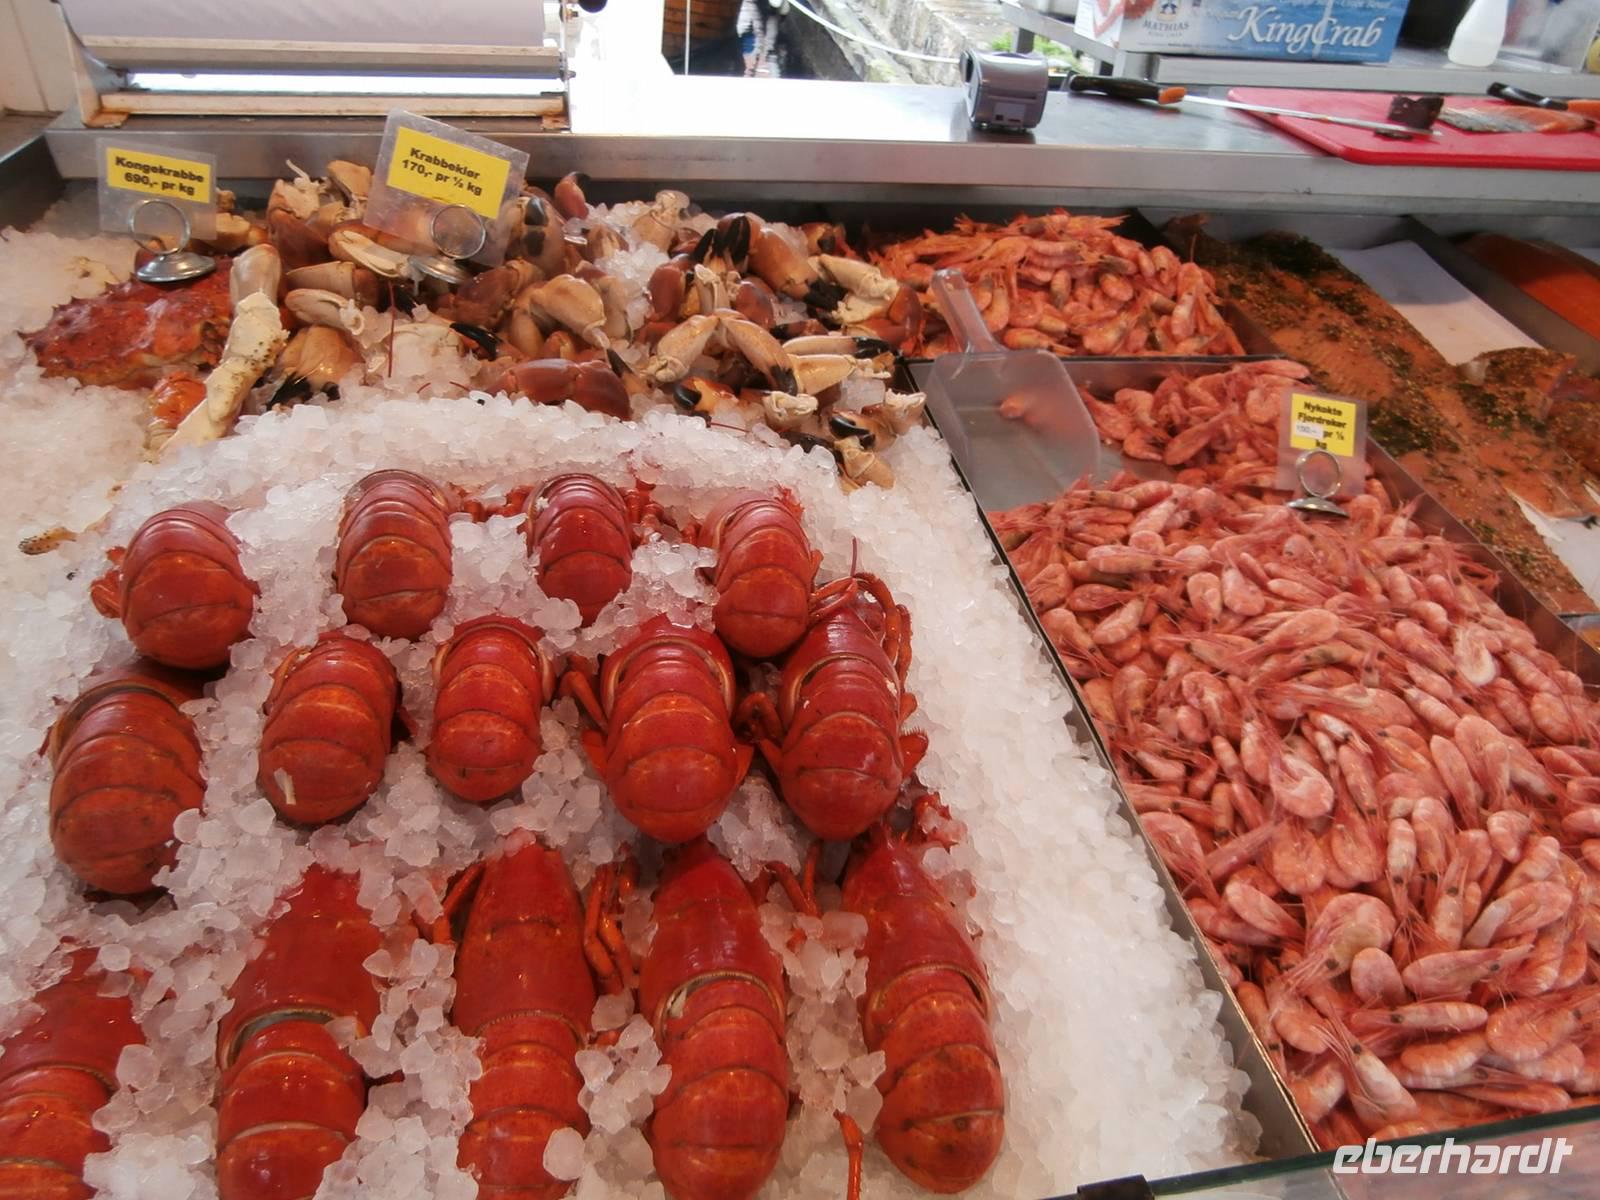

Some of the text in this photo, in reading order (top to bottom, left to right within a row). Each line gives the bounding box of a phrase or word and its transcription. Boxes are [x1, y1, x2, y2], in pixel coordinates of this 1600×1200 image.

[1142, 20, 1190, 32] MATHIAS
[115, 156, 205, 183] Kongekrabbe
[402, 159, 433, 178] 170,-
[434, 172, 450, 183] pr
[466, 182, 483, 197] kg
[124, 172, 195, 197] 690,- pr kg
[1303, 401, 1343, 417] Nykokte
[1323, 430, 1334, 439] pr
